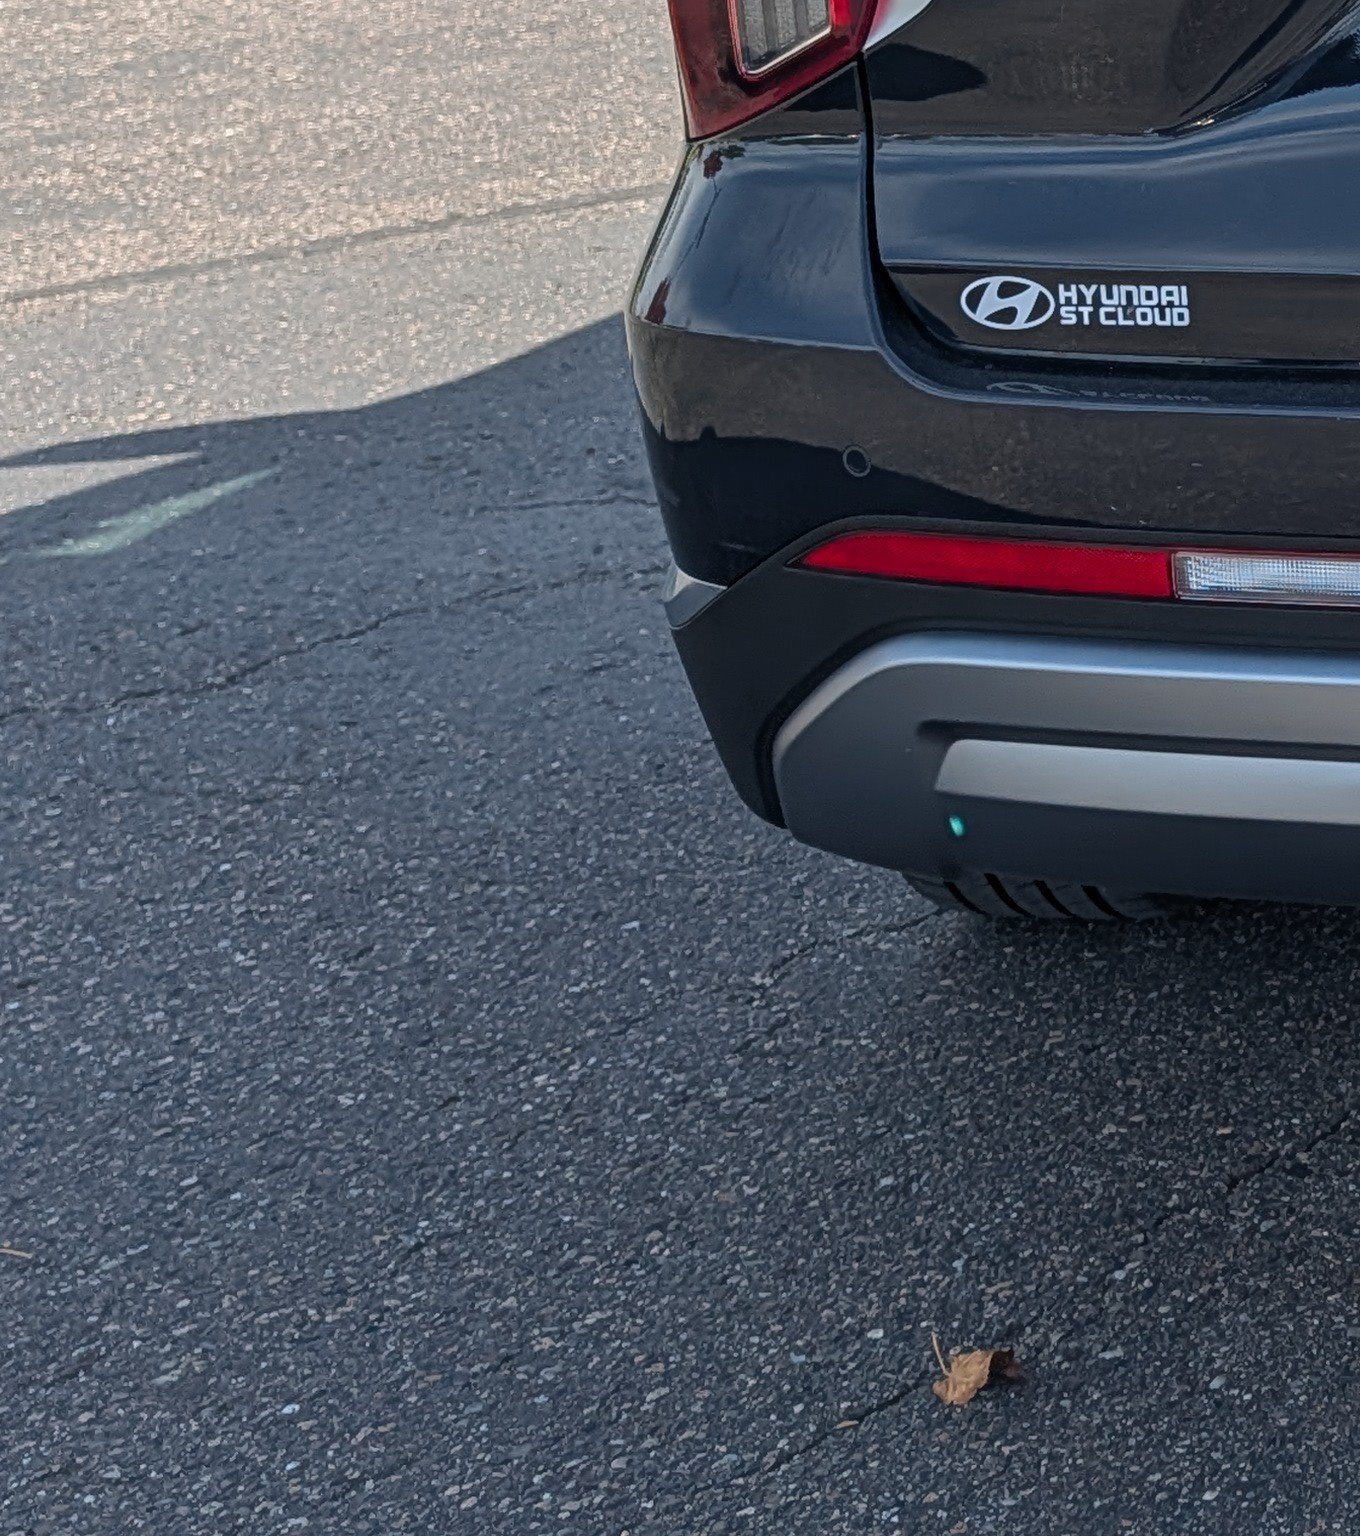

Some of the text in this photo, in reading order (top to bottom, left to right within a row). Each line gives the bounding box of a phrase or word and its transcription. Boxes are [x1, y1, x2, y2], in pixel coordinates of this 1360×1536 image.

[1057, 282, 1189, 307] HYUNDAI
[1059, 306, 1191, 327] ST CLOUD
